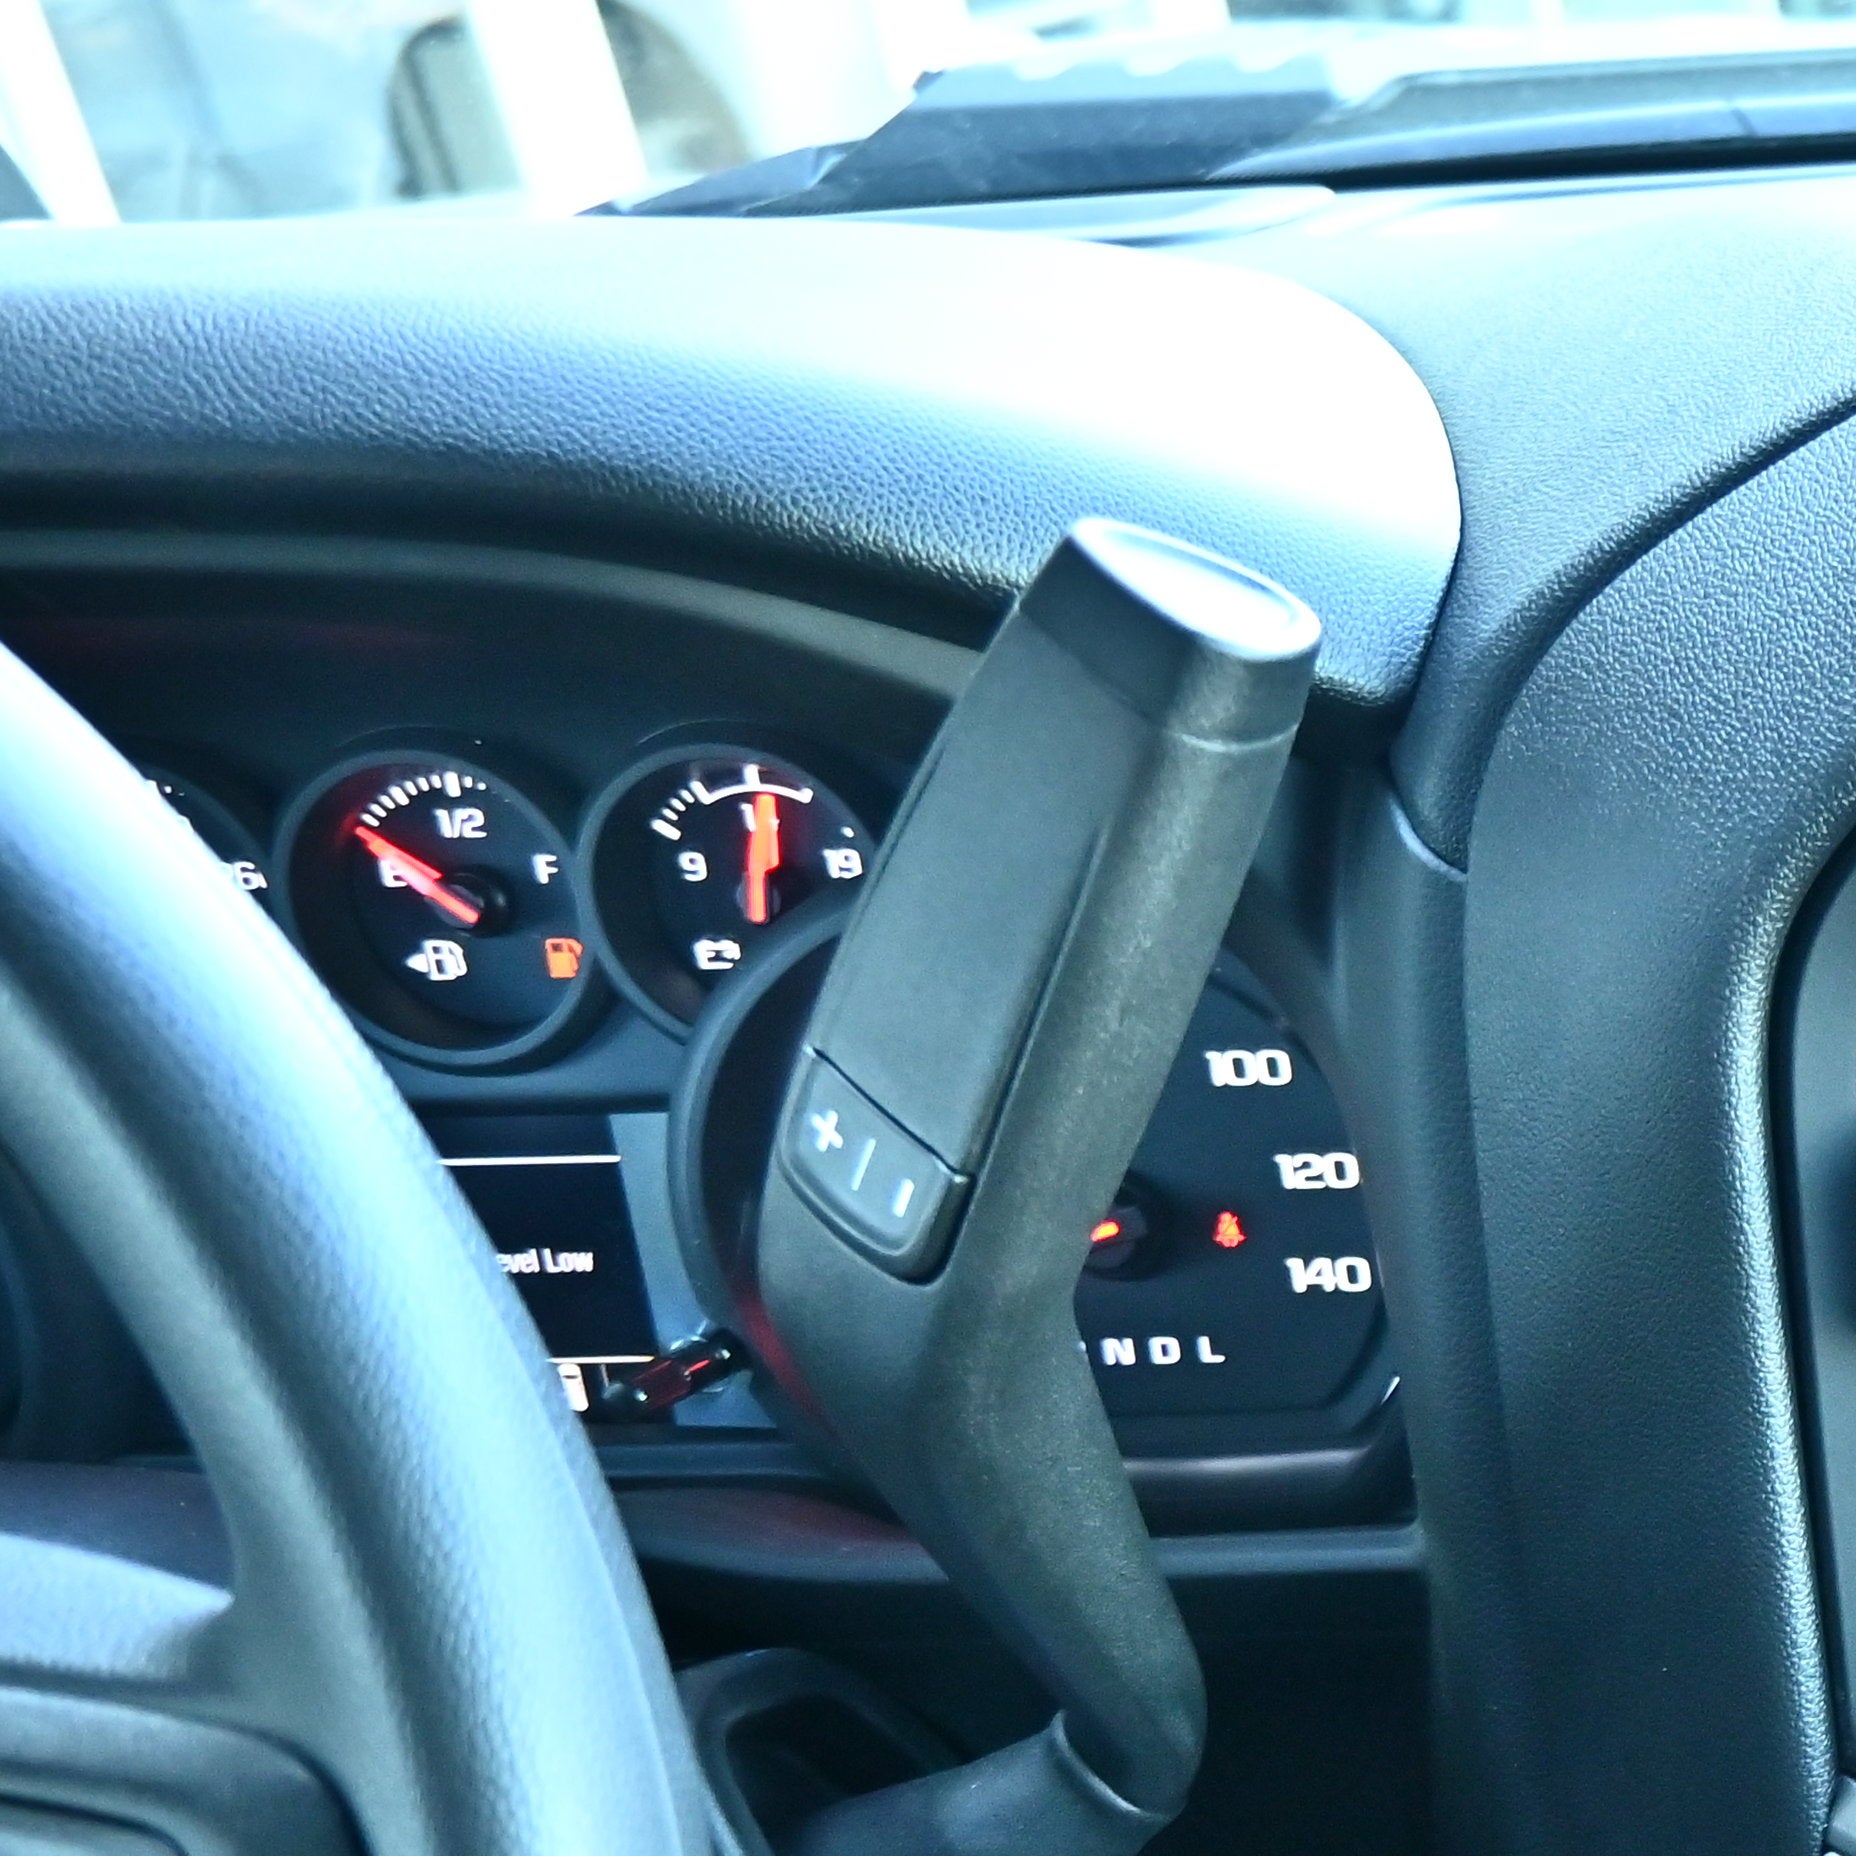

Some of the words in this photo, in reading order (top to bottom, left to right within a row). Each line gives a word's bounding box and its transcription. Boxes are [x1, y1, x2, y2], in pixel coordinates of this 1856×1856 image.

[435, 807, 487, 838] 1/2
[532, 854, 558, 884] F
[678, 851, 708, 882] 9
[822, 848, 863, 879] 19
[1204, 1049, 1292, 1087] 100
[1273, 1152, 1360, 1189] 120
[495, 1248, 539, 1273] evel
[542, 1248, 594, 1273] Low
[1285, 1256, 1372, 1293] 140
[1100, 1337, 1136, 1365] N
[1148, 1336, 1181, 1364] D
[1197, 1336, 1226, 1363] L
